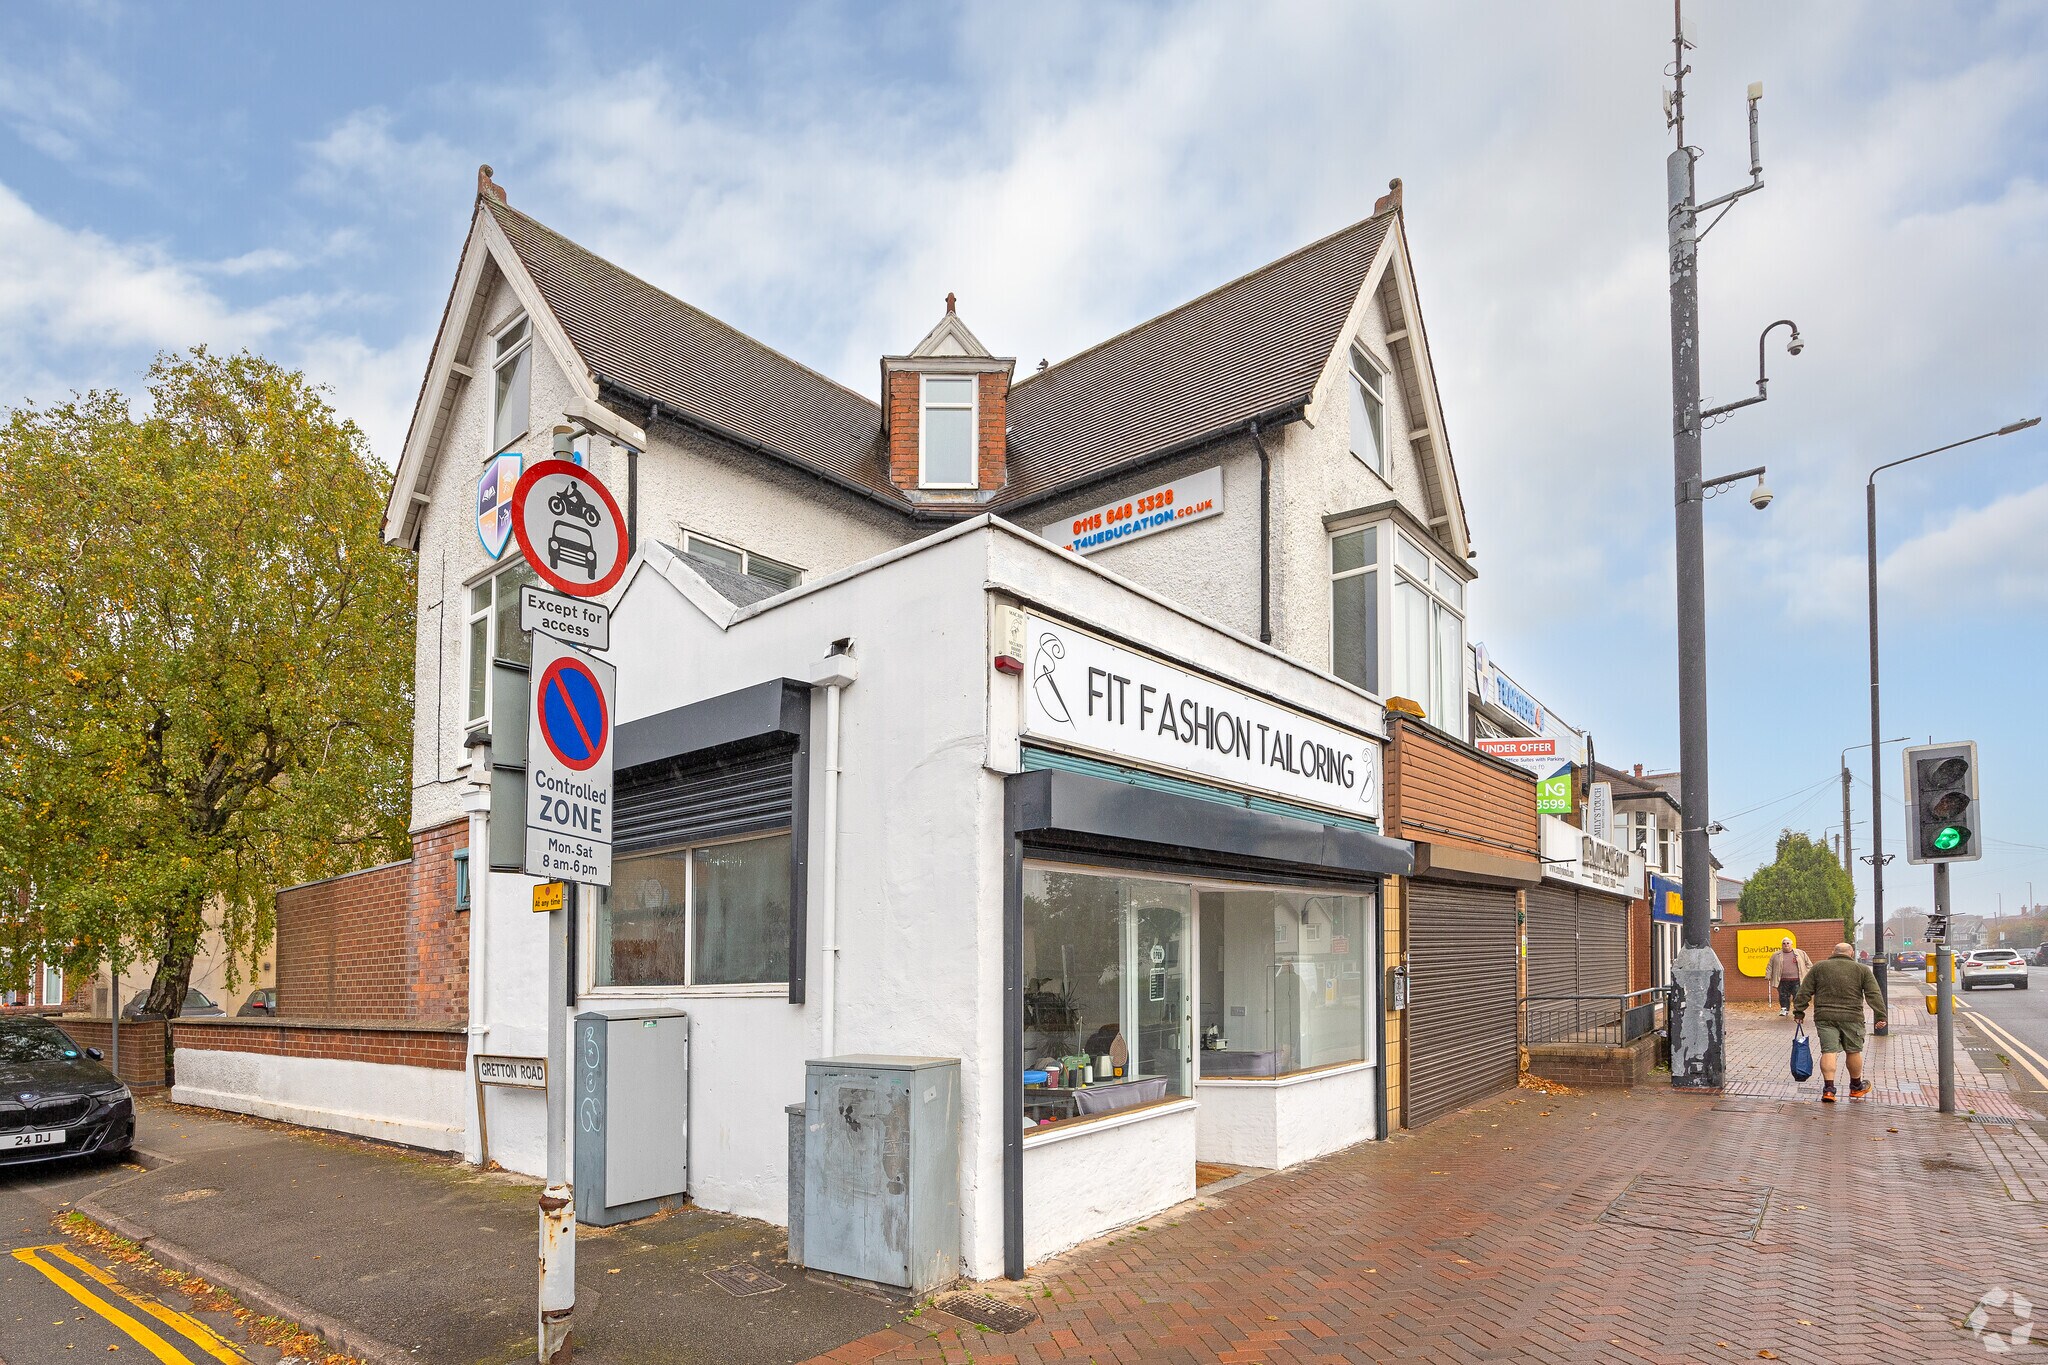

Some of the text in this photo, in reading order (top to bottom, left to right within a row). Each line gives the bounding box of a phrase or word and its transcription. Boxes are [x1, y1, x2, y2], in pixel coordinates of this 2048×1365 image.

[1073, 489, 1174, 535] 0115 648 3328
[528, 594, 602, 623] Except for
[542, 618, 589, 637] access
[1088, 666, 1354, 788] FIT FASHION TAILORING
[1481, 743, 1551, 753] UNDER OFFER
[535, 770, 607, 805] Controlled
[1545, 783, 1565, 796] NG
[540, 795, 601, 833] ZONE
[543, 854, 550, 867] 8
[582, 865, 597, 875] pm
[551, 898, 560, 906] time
[1743, 946, 1780, 954] DavidJam
[481, 1062, 543, 1080] GRETTON ROAD
[15, 1133, 51, 1145] 24 DJ
